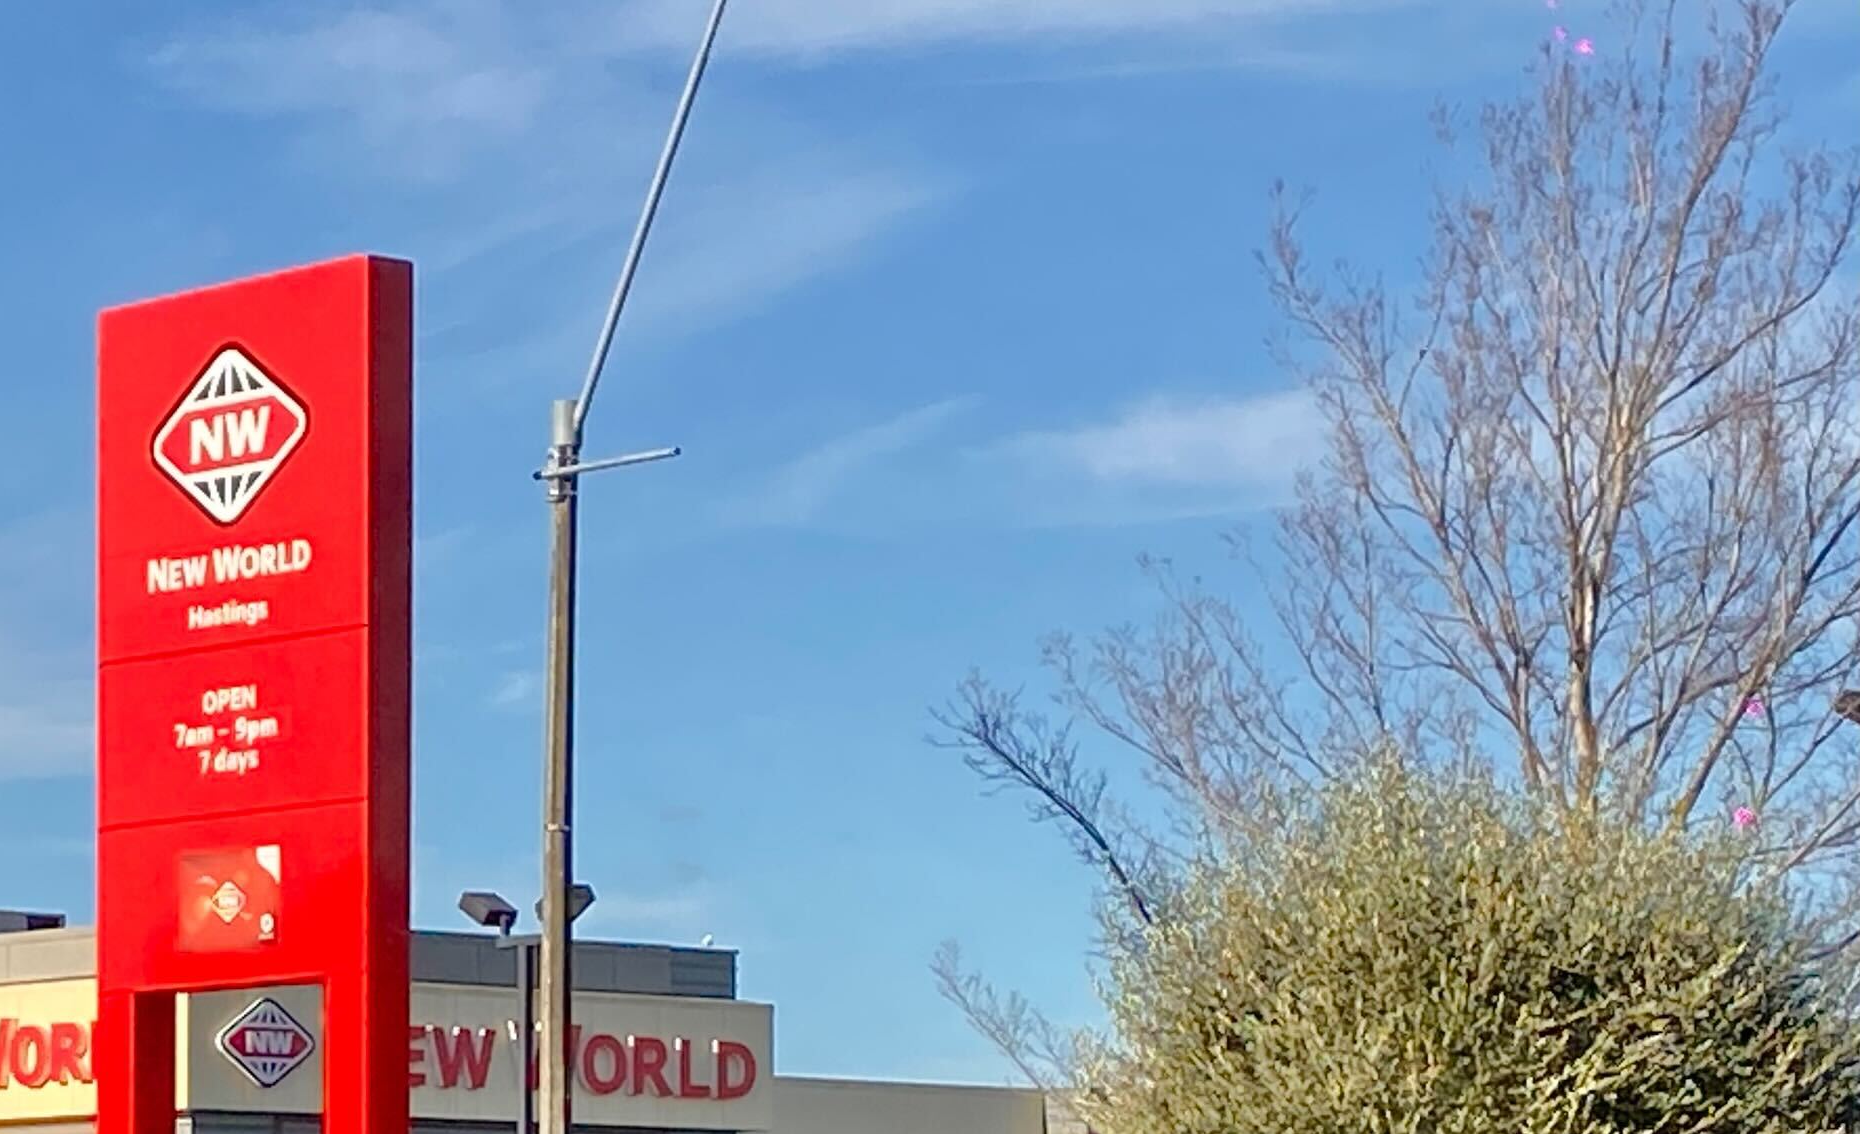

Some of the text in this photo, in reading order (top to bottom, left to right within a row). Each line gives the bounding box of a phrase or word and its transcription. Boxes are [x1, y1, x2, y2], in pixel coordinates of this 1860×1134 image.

[190, 404, 271, 466] NW
[147, 539, 312, 594] NEW WORLD
[187, 600, 270, 630] Hastings
[201, 684, 258, 715] OPEN
[173, 723, 215, 749] 7am
[234, 715, 279, 746] 9pm
[198, 746, 260, 776] 7 days
[244, 1029, 295, 1055] NW
[408, 1019, 757, 1101] EW ORLD
